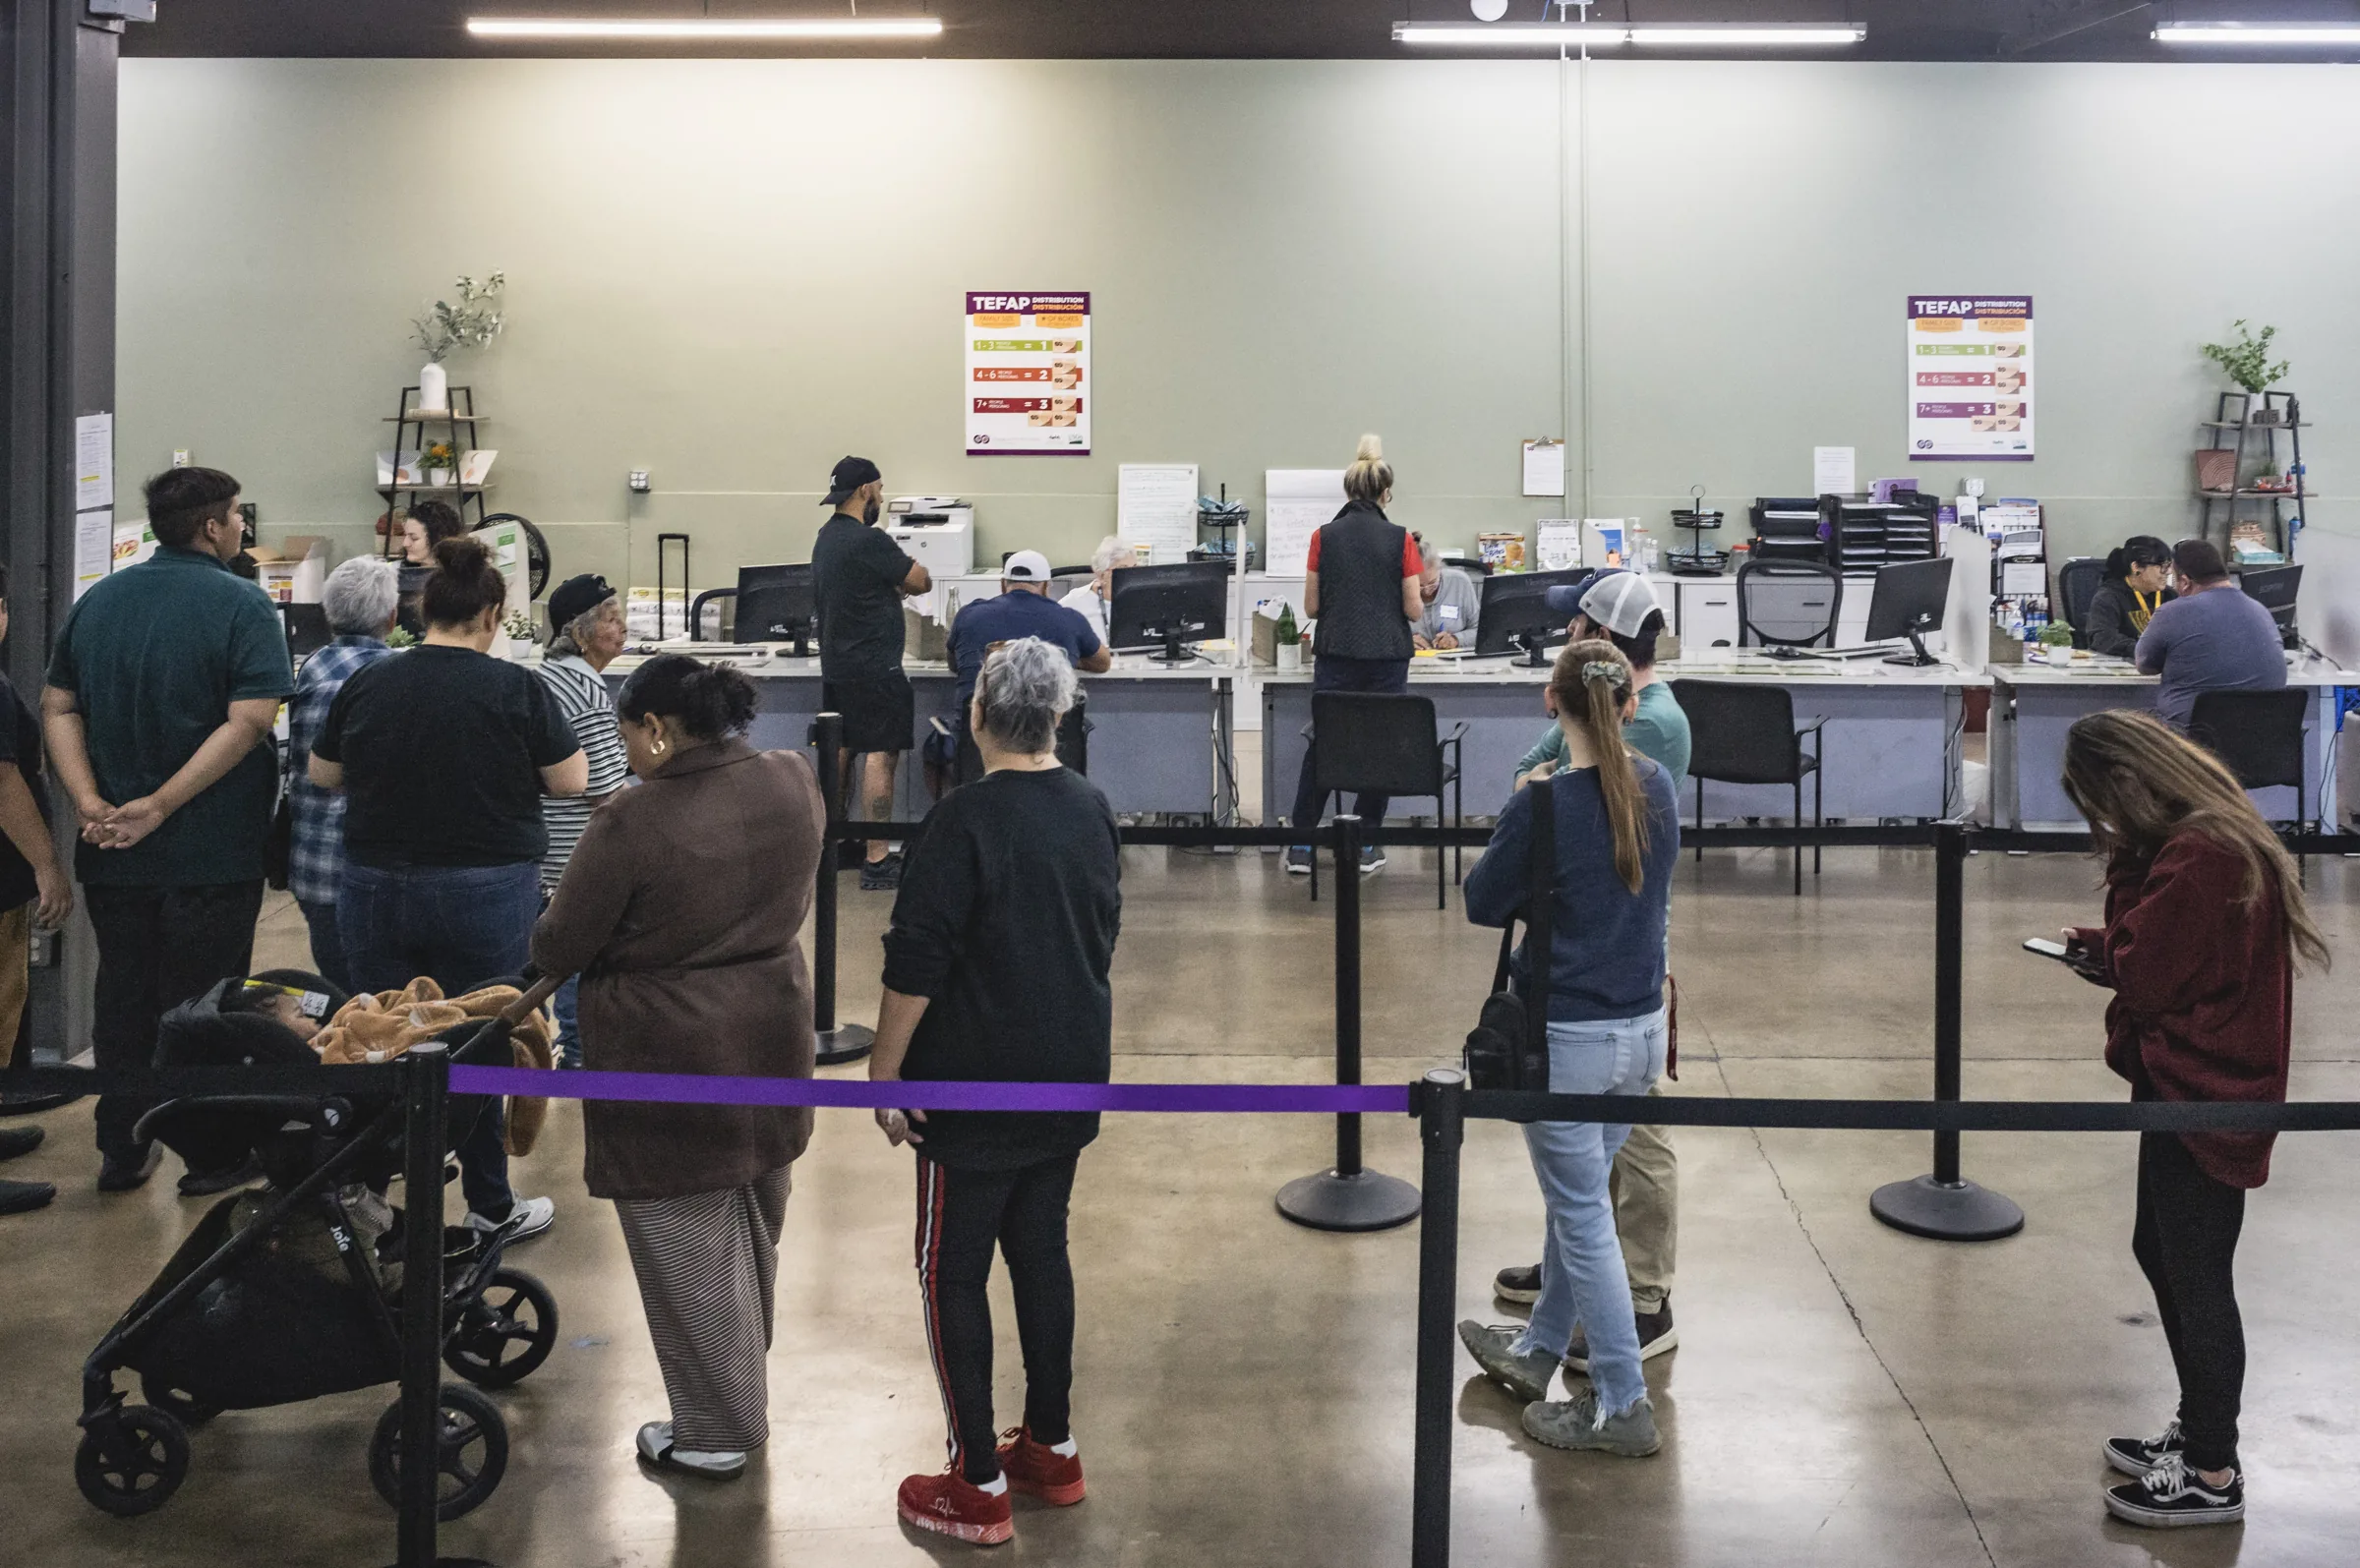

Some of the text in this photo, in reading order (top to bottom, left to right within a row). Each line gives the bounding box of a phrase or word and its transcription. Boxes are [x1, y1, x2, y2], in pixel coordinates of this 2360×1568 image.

[973, 296, 1031, 311] TEFAP
[1915, 300, 1973, 315] TEFAP
[1040, 340, 1047, 351] 1
[1982, 345, 1990, 355] 1
[1039, 370, 1048, 380] 2
[1981, 375, 1991, 384] 2
[975, 399, 988, 409] 7+
[1039, 399, 1048, 410] 3
[1919, 404, 1931, 414] 7+
[1982, 404, 1991, 414] 3
[329, 1226, 351, 1252] Joie
